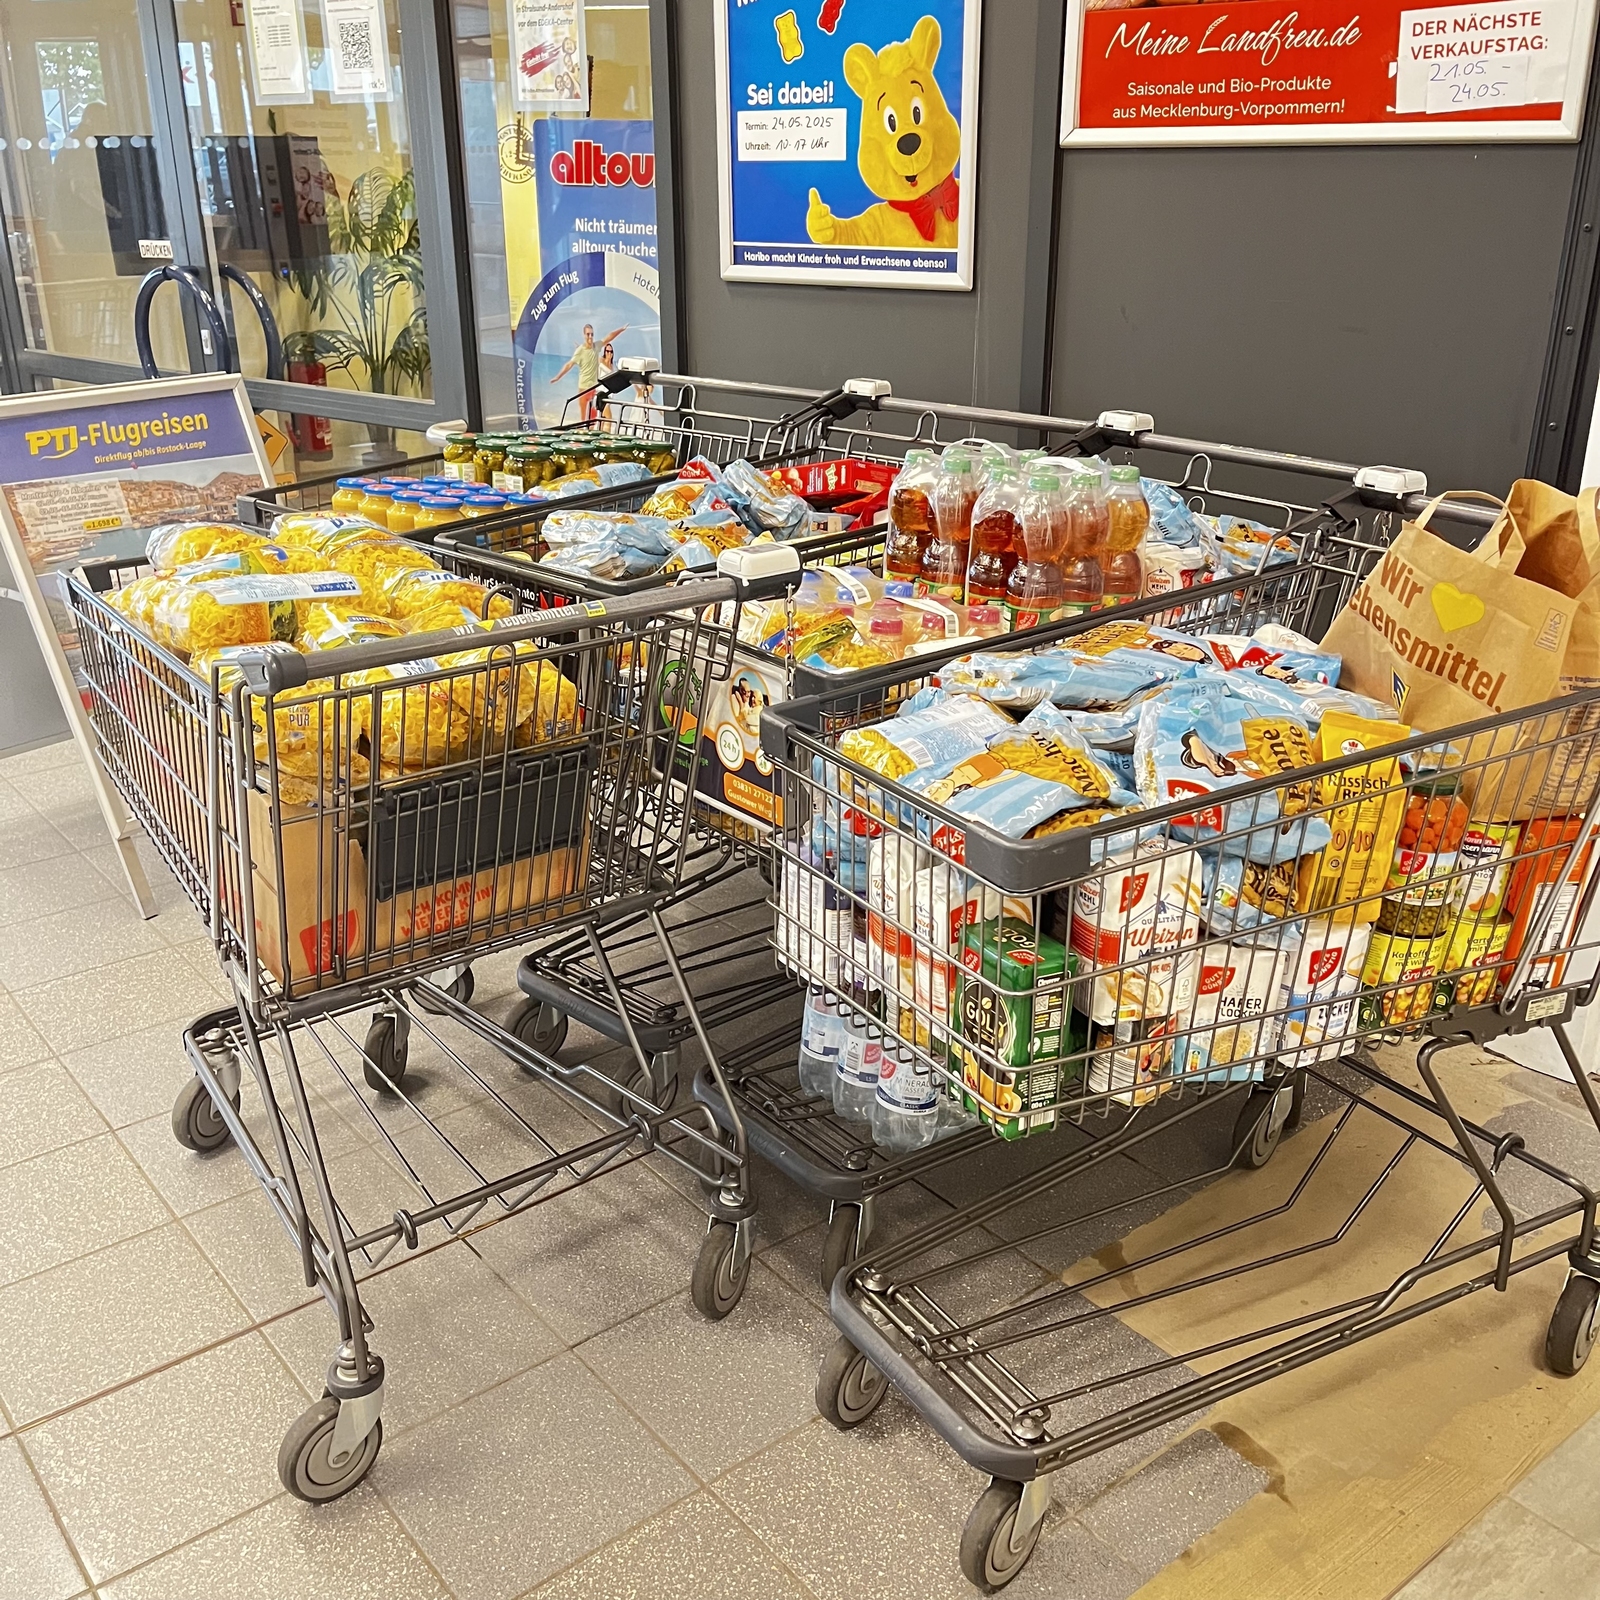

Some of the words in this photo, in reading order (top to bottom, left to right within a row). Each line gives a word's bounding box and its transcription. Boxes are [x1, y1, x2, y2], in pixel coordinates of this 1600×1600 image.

[527, 19, 538, 27] dem
[1412, 20, 1447, 37] DER
[1453, 11, 1542, 33] NÄCHSTE
[1105, 22, 1191, 58] Meine
[1196, 11, 1362, 66] Landfreu.de
[1411, 35, 1548, 60] VERKAUFSTAG:
[1430, 60, 1489, 82] 21.05.
[747, 83, 773, 106] Sei
[777, 80, 834, 105] dabei!
[1127, 80, 1194, 96] Saisonale
[1198, 79, 1225, 94] und
[1230, 76, 1332, 93] Bio-Produkte
[1449, 82, 1509, 103] 24.05.
[1112, 107, 1137, 119] aus
[1140, 99, 1345, 120] Mecklenburg-Vorpommern!
[744, 122, 769, 131] Termin:
[771, 116, 834, 131] 24.05.2025
[744, 141, 771, 151] Uhrzeit:
[810, 137, 830, 149] Uhr
[575, 217, 605, 233] Nicht
[141, 242, 172, 257] DRÜCKEN
[572, 238, 615, 253] alltours
[744, 251, 770, 262] Haribo
[771, 253, 796, 263] macht
[797, 253, 823, 265] Kinder
[824, 254, 841, 265] froh
[843, 255, 859, 266] und
[861, 256, 911, 268] Erwachsene
[912, 257, 947, 269] ebenso!
[530, 299, 548, 321] Zug
[543, 281, 561, 299] zum
[558, 270, 580, 288] Flug
[516, 358, 526, 414] Deutsche
[94, 449, 133, 465] Direktflug
[133, 445, 156, 458] ab/bis
[156, 440, 207, 455] Rostock-Laage
[1380, 549, 1424, 609] Wir
[451, 623, 475, 637] Wir
[289, 713, 310, 727] PUR
[1127, 927, 1194, 948] Weizen
